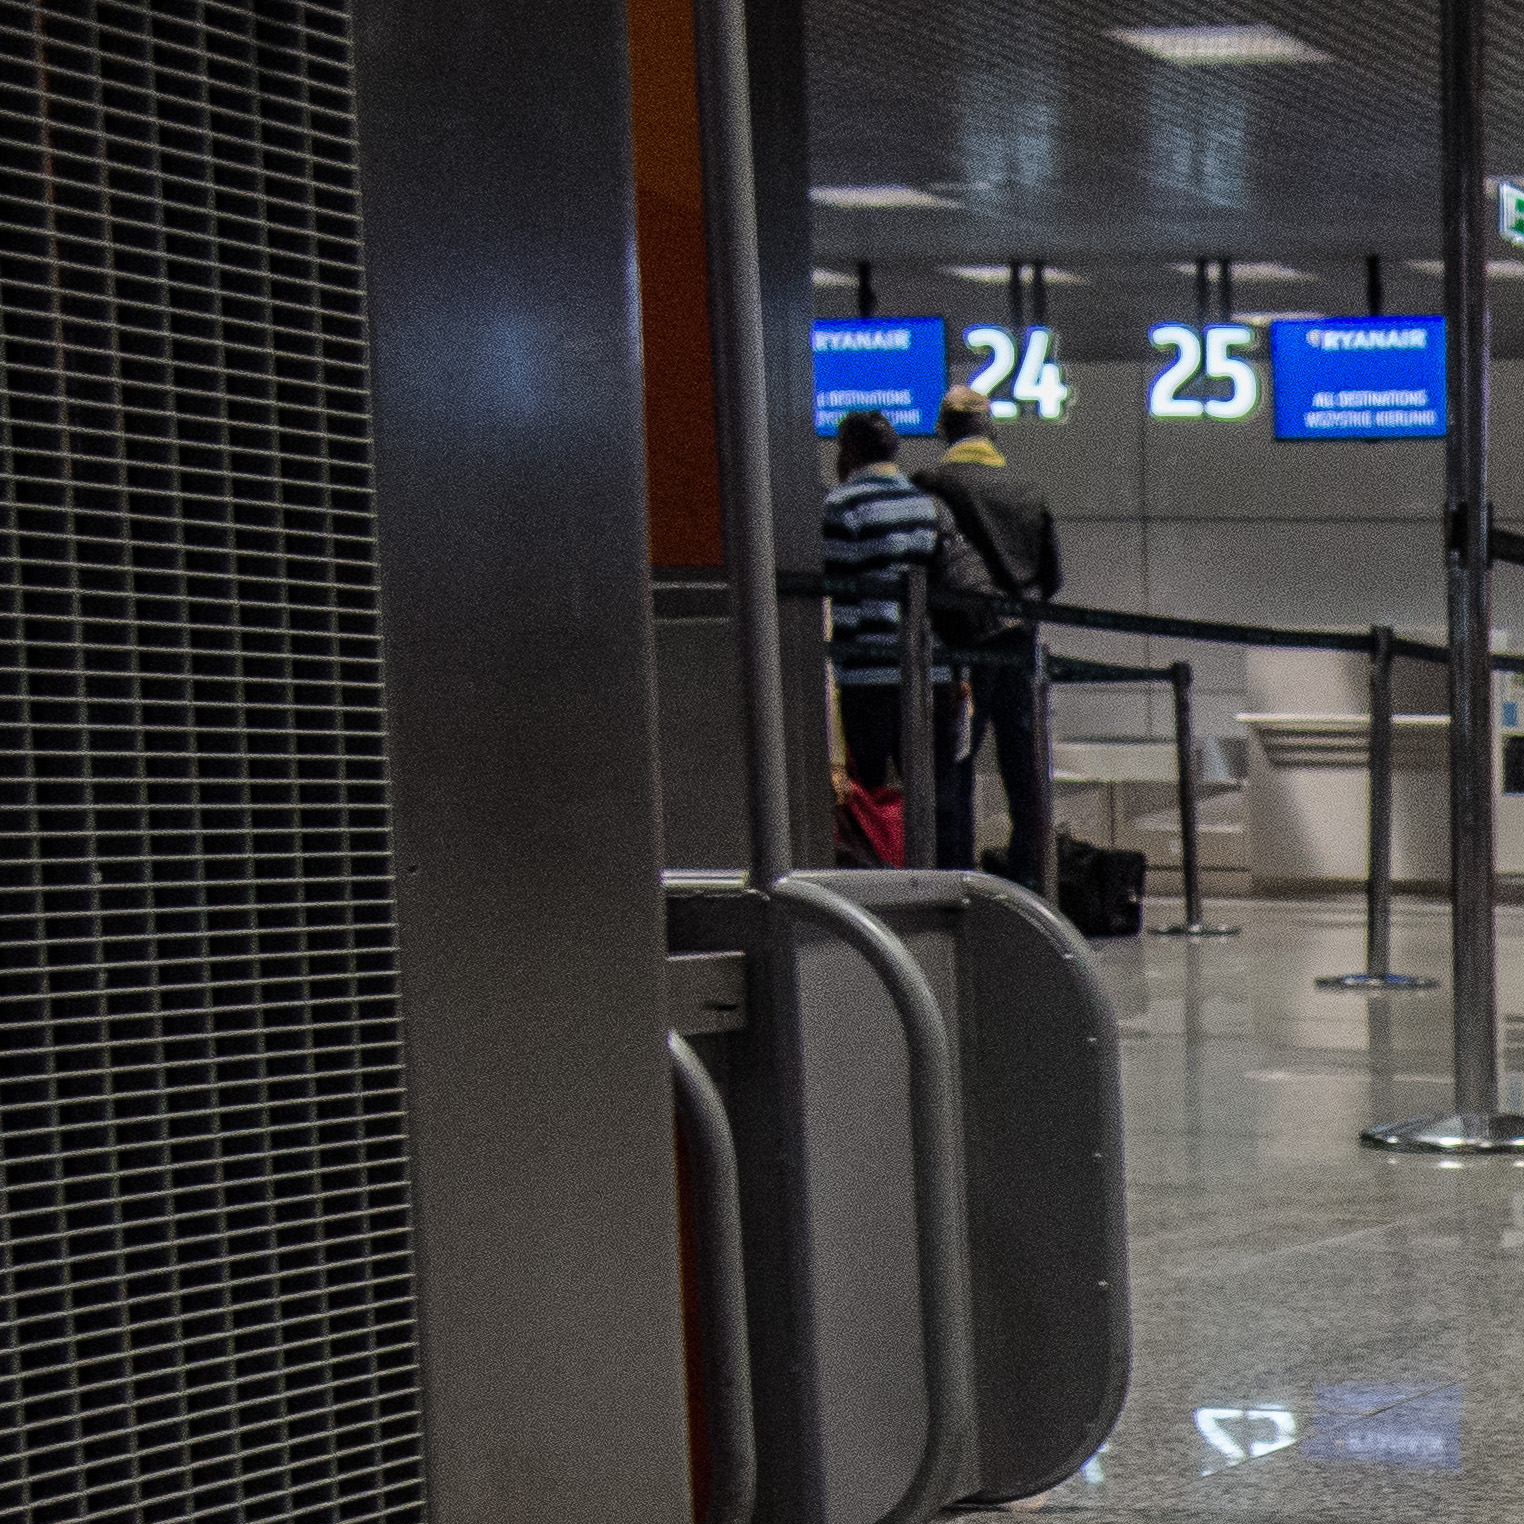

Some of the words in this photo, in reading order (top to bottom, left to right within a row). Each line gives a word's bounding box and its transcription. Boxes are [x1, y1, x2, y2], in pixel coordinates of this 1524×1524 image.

[813, 329, 910, 351] RYANAIR
[1321, 329, 1428, 351] RYANAIR
[965, 326, 1069, 420] 24
[1149, 325, 1258, 420] 25
